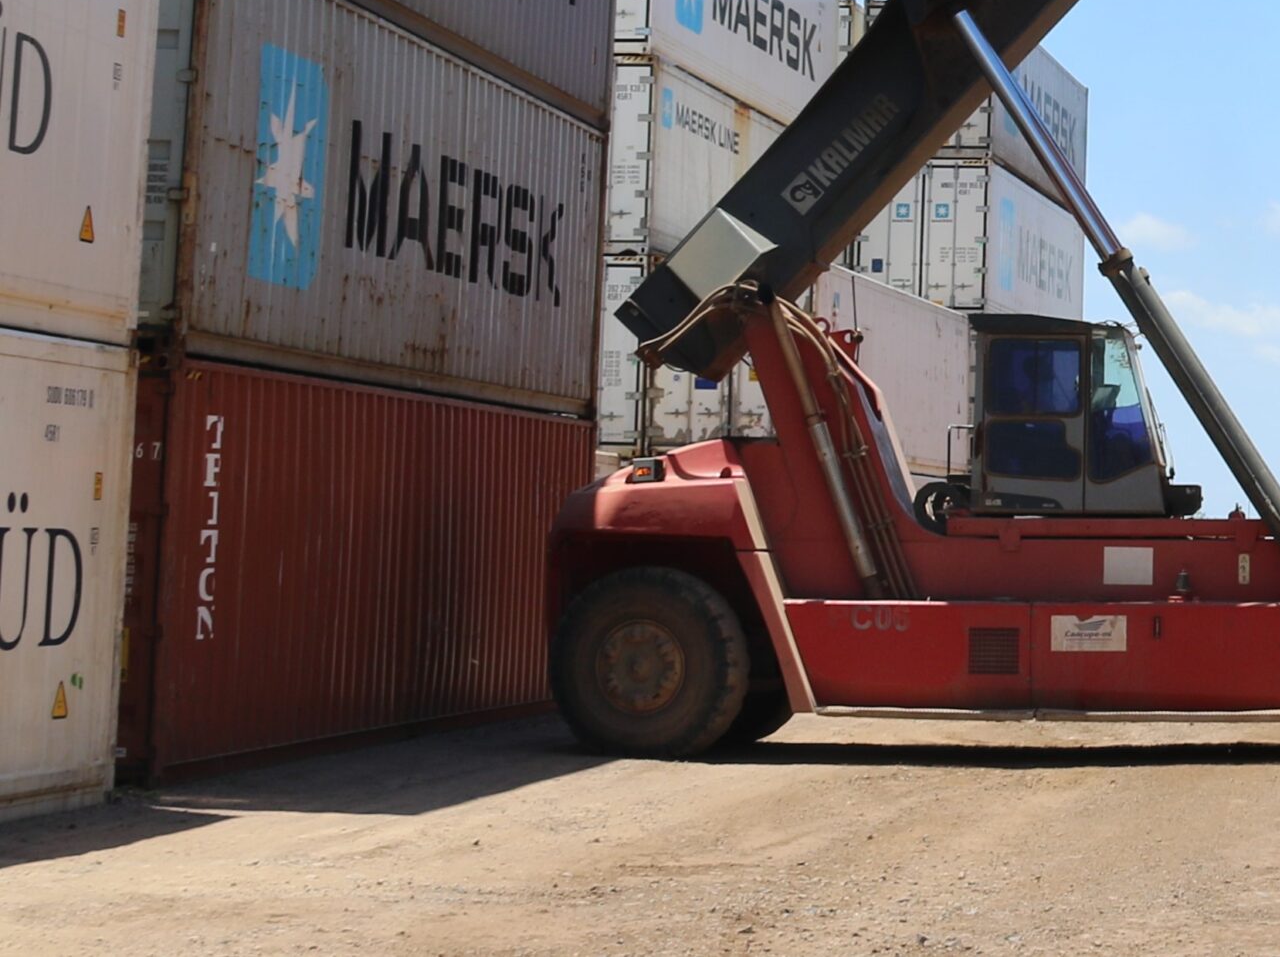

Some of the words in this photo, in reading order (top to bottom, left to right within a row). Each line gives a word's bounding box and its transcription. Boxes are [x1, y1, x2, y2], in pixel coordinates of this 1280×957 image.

[676, 101, 717, 145] MAERSK
[718, 124, 740, 155] LINE
[808, 92, 900, 188] KALMAR
[345, 119, 564, 307] MAERSK
[1017, 224, 1073, 303] MAERSK
